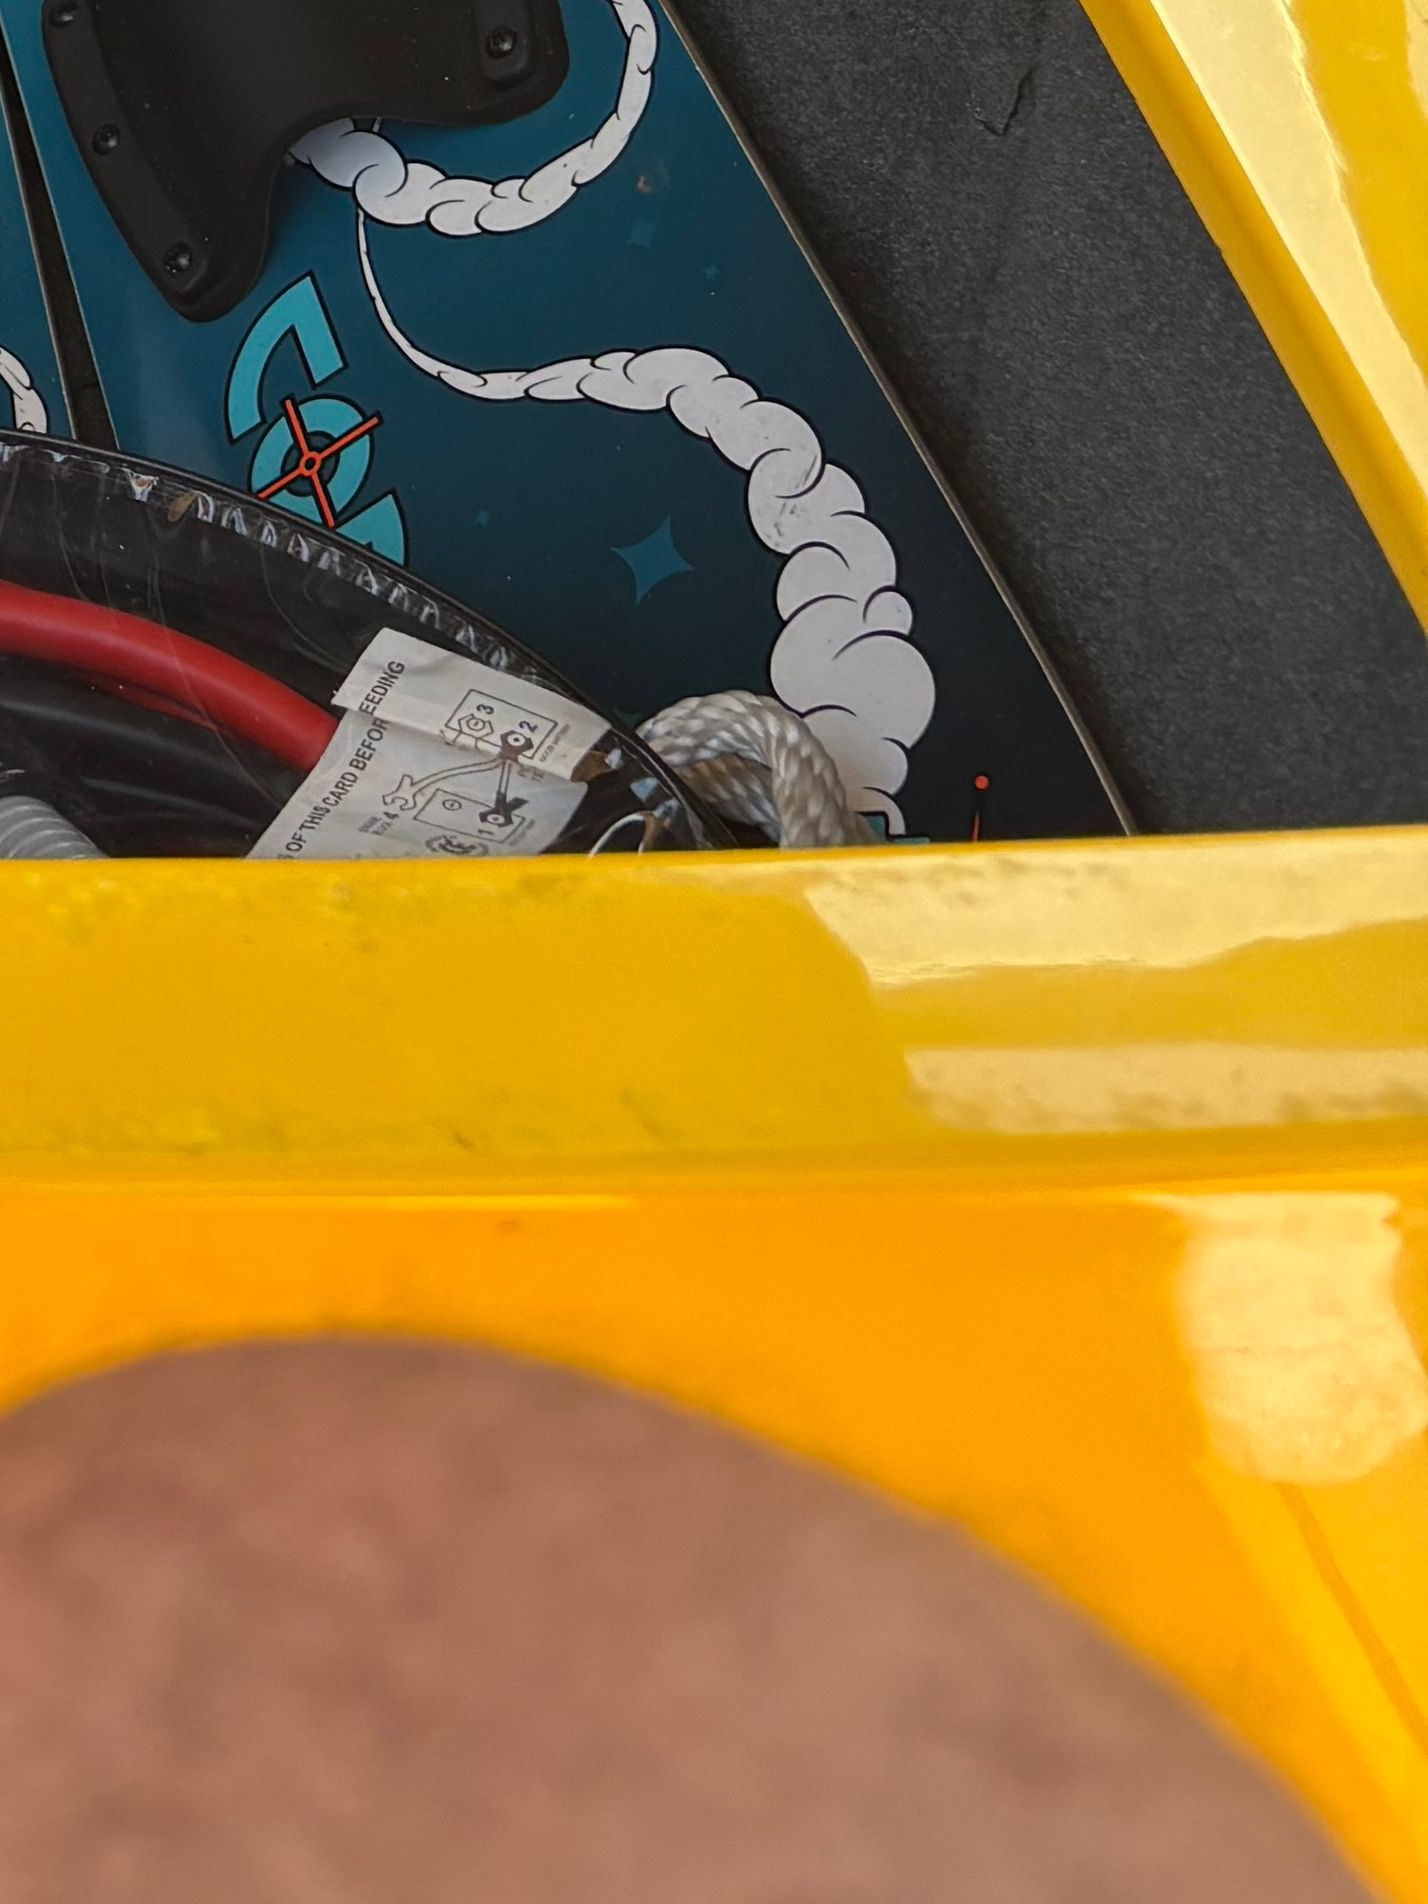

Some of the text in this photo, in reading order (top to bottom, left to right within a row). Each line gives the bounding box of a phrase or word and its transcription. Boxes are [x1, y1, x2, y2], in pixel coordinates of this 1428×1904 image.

[476, 703, 495, 715] 3
[519, 720, 539, 734] 2
[285, 719, 390, 852] OF THIS CARD BEFOR
